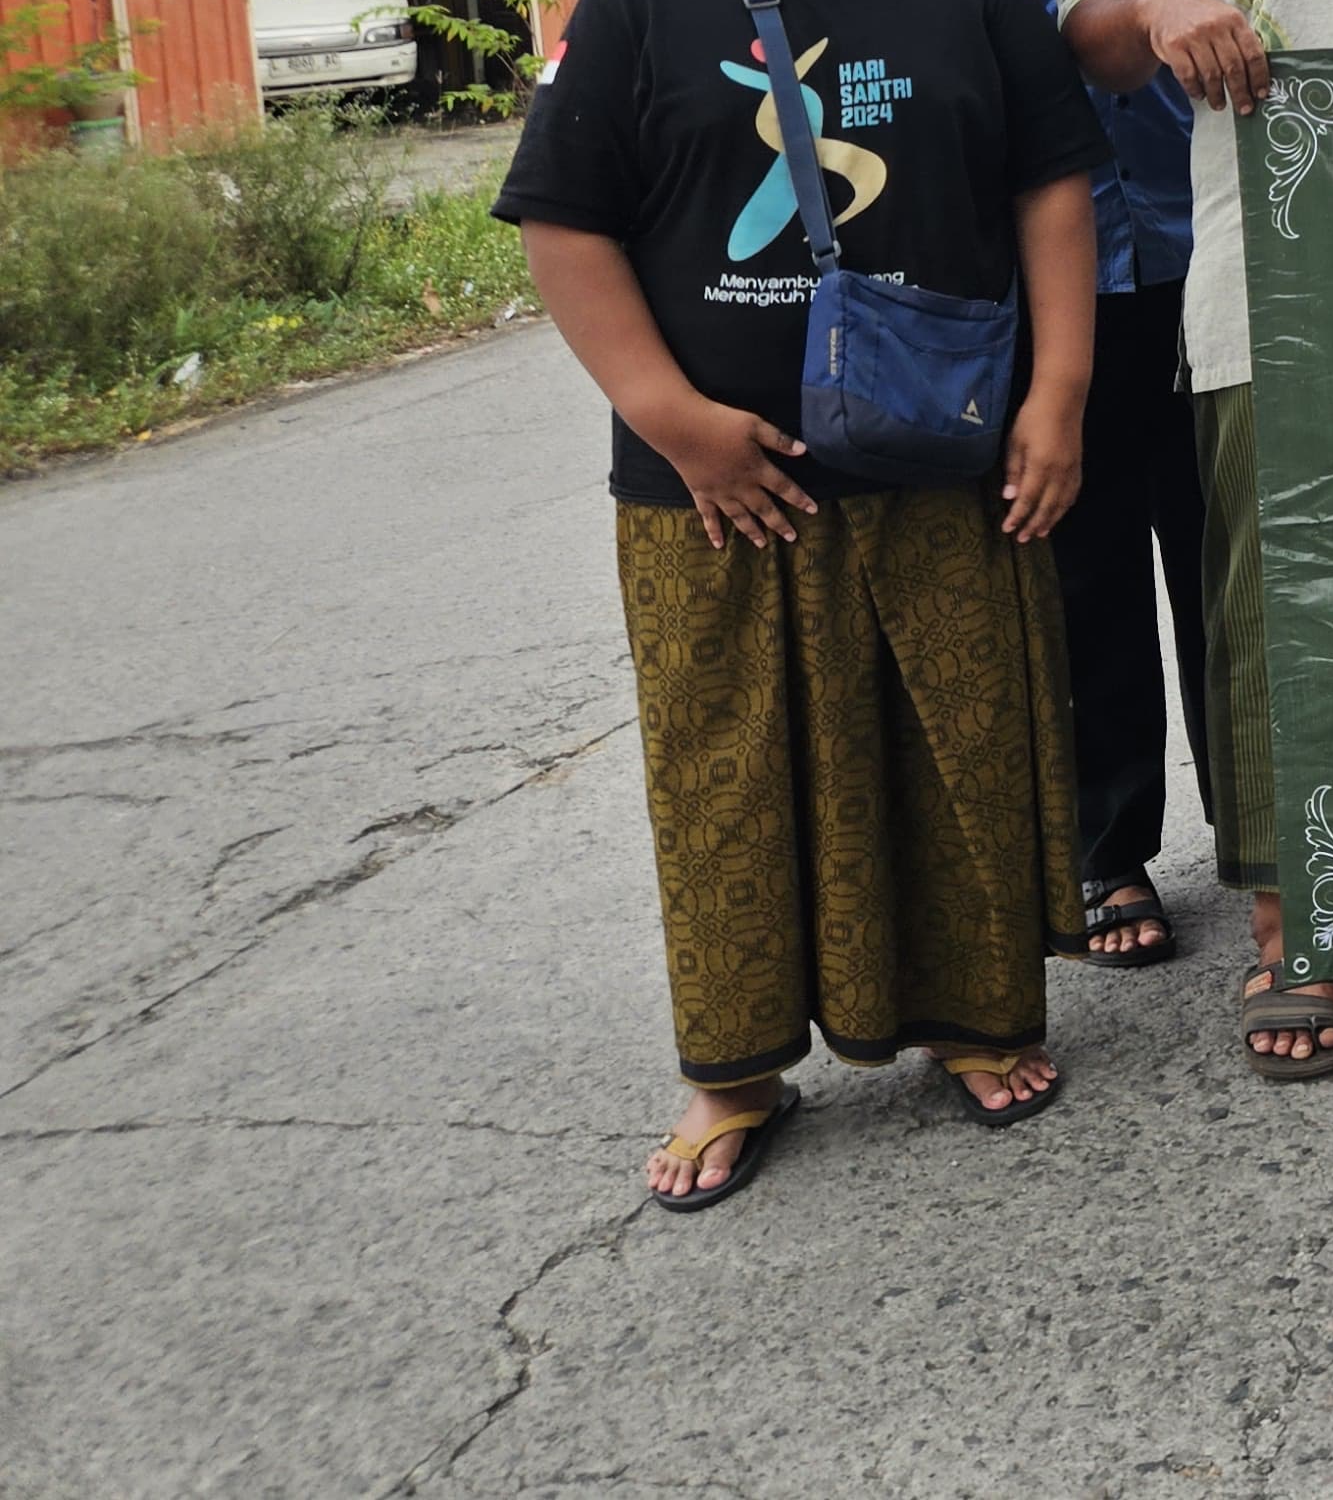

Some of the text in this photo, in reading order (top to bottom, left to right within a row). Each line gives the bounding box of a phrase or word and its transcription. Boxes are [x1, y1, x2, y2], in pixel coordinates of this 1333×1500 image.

[839, 59, 885, 84] HARI
[840, 77, 912, 106] SANTRI
[841, 102, 893, 129] 2024
[720, 273, 821, 293] Menyambu
[704, 285, 805, 307] Merengkuh
